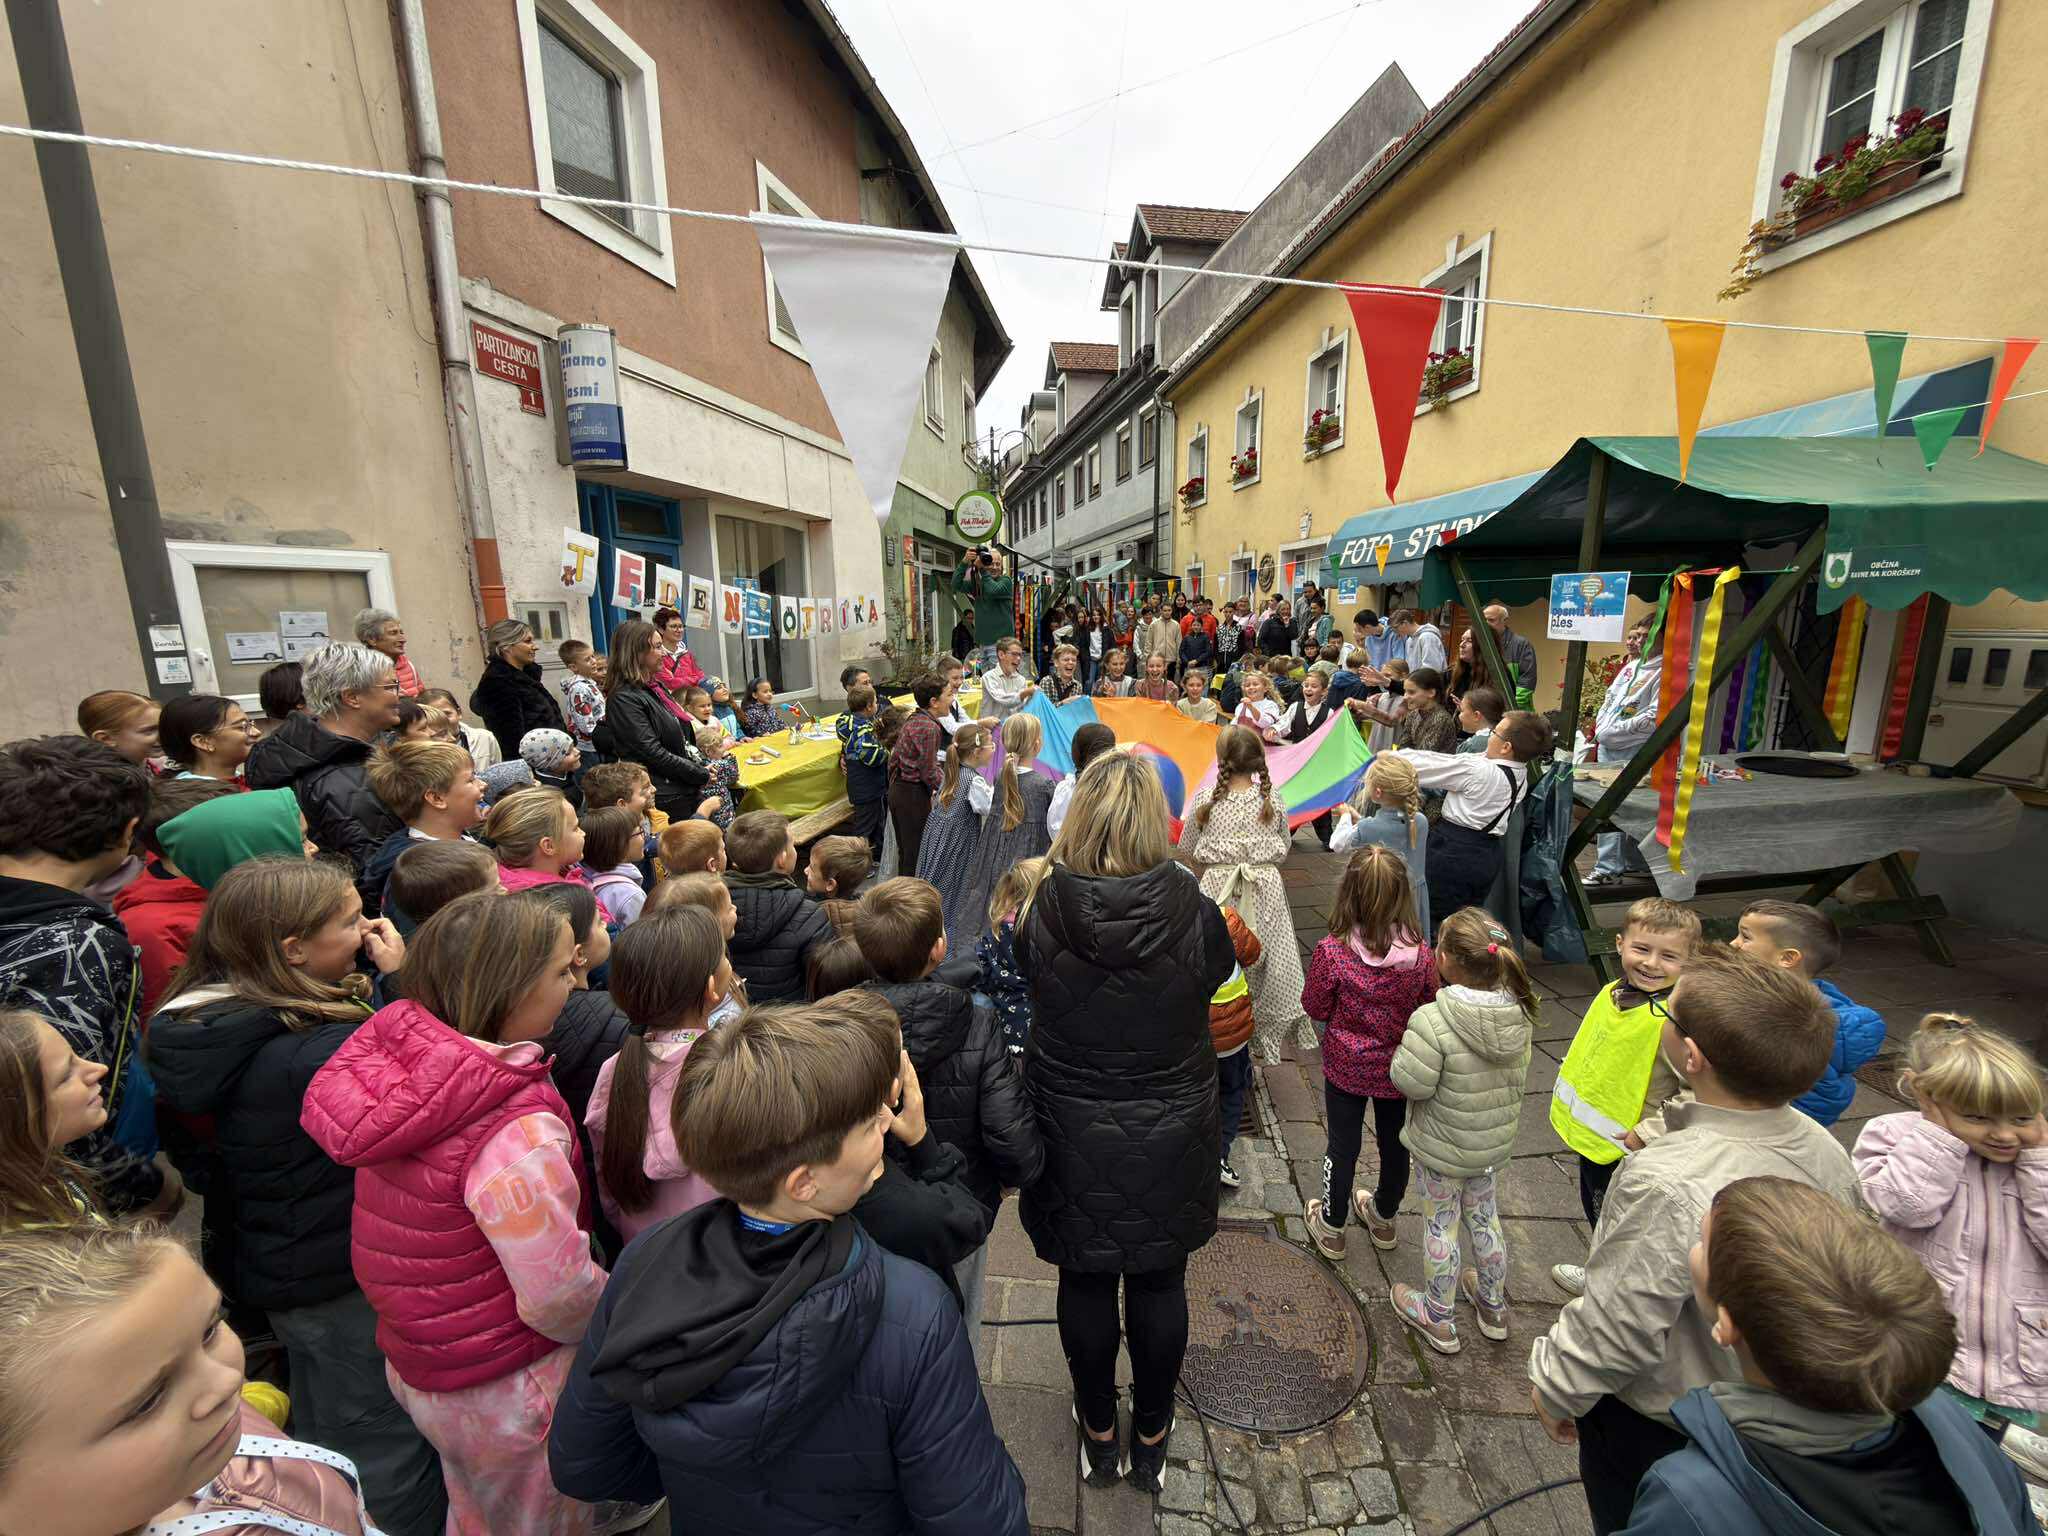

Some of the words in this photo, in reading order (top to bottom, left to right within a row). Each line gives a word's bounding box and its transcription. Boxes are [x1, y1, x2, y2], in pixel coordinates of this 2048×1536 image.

[476, 330, 539, 369] PARTIZANSKA
[560, 338, 572, 355] Mi
[493, 357, 528, 381] CESTA
[560, 354, 607, 369] znamo
[529, 392, 536, 406] 1
[1339, 533, 1394, 567] FOTO
[1870, 560, 1900, 569] OBČINA
[1870, 570, 1880, 578] NA
[1881, 567, 1921, 578] KOROŠKEM
[566, 541, 741, 624] TEDEN
[782, 599, 879, 635] OTROKA
